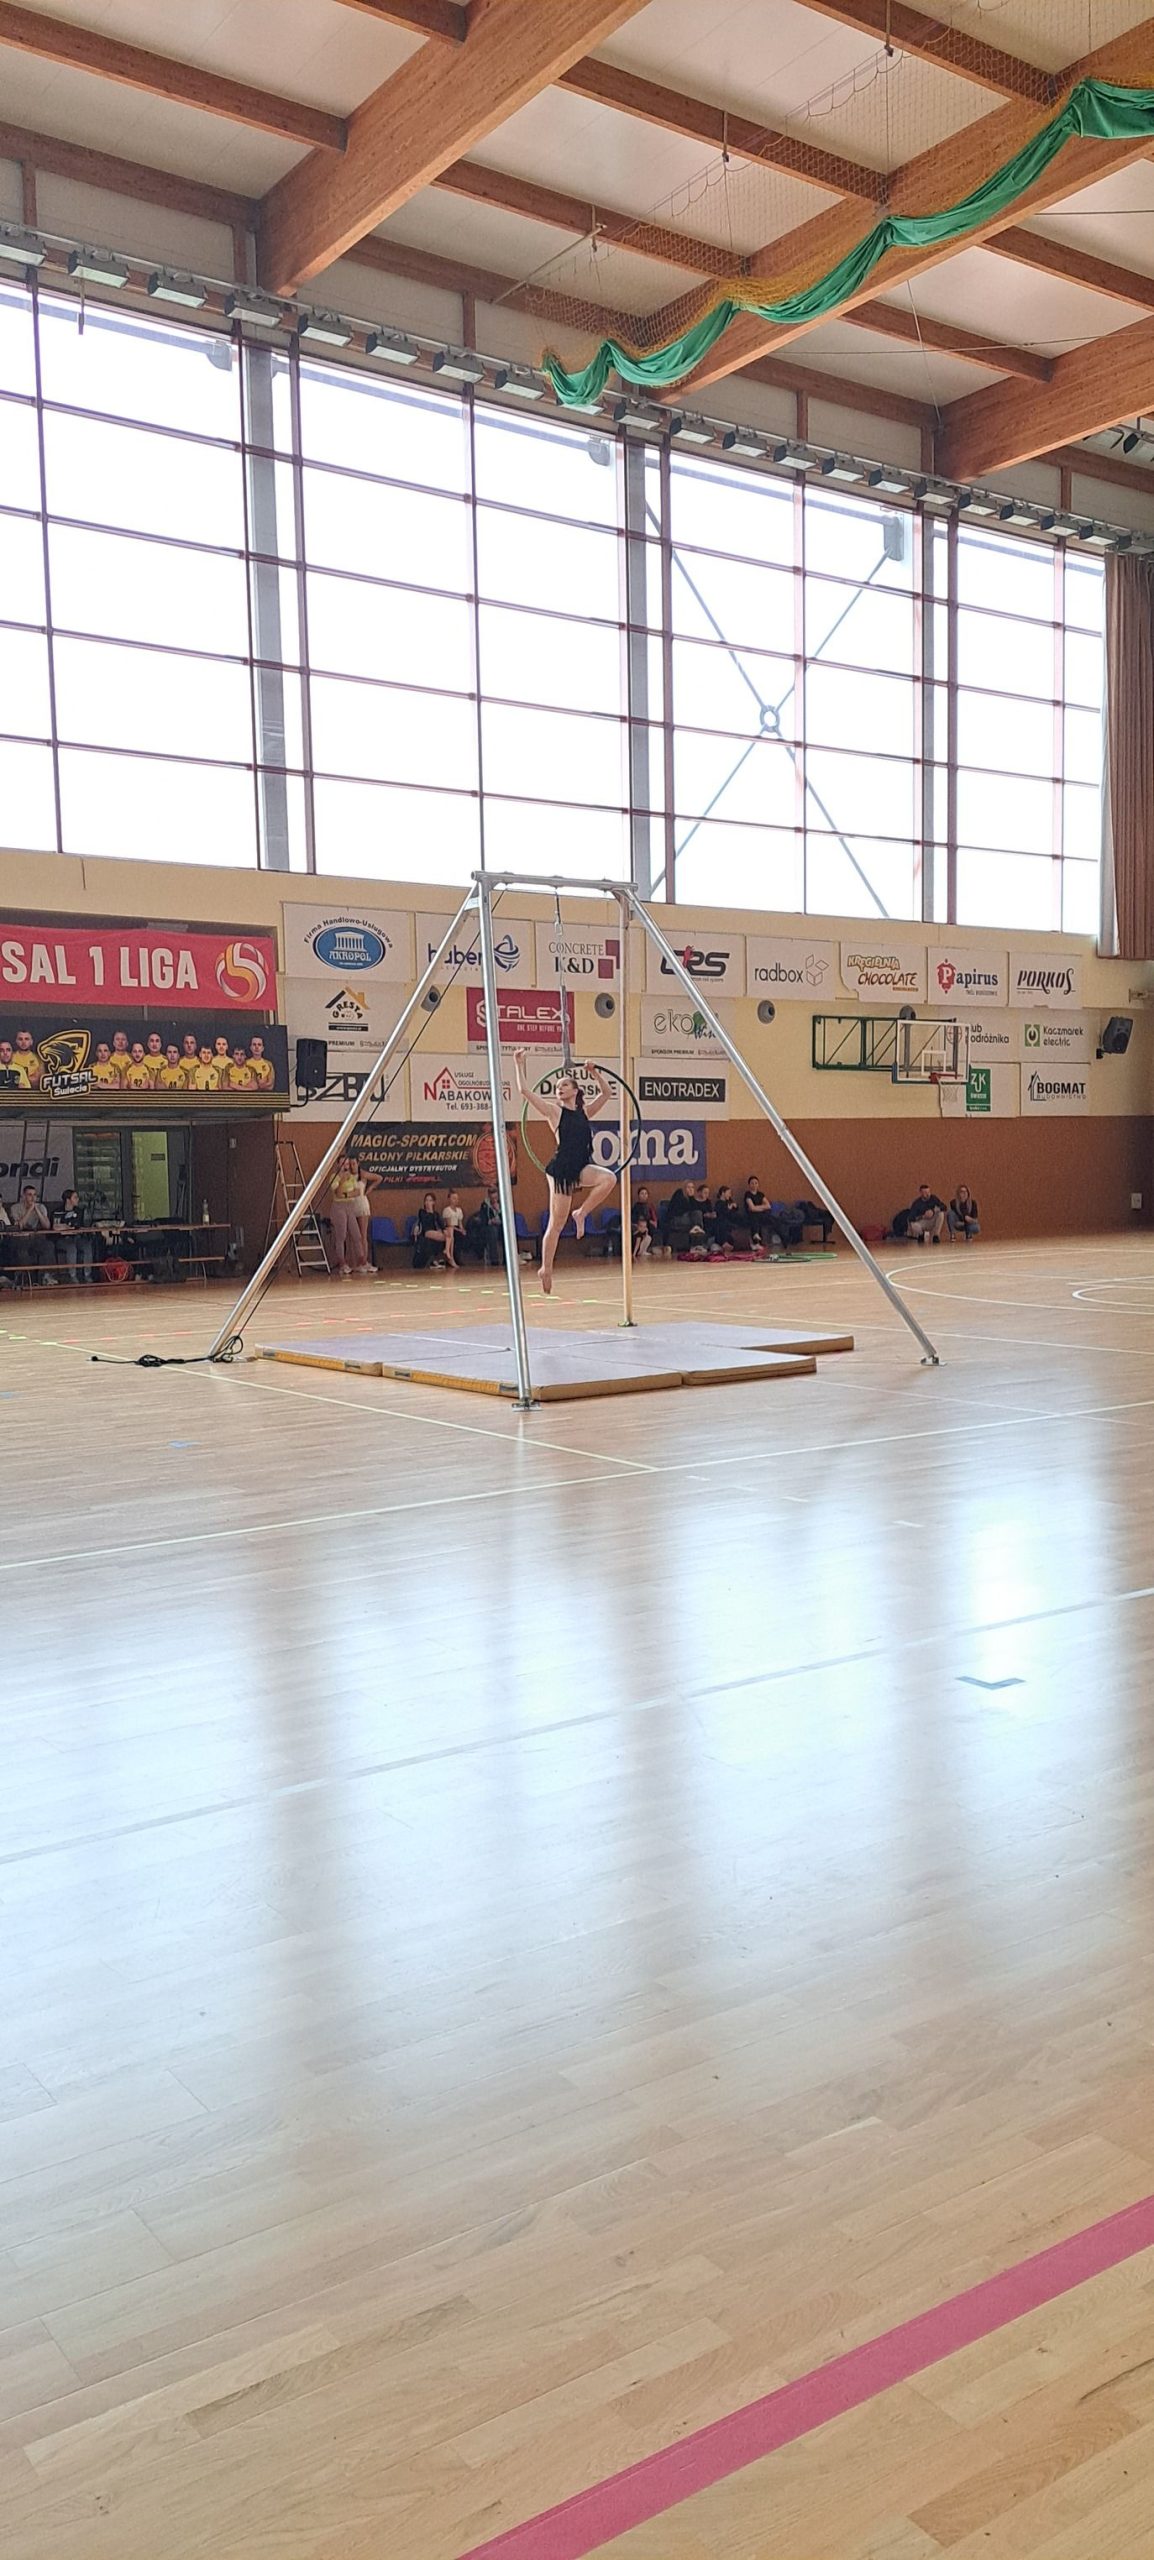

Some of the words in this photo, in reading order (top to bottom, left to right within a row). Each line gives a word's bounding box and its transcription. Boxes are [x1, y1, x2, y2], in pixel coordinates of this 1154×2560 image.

[304, 924, 323, 944] Firma
[329, 951, 372, 961] AKROPOL
[548, 942, 605, 955] CONCRETE
[1, 941, 76, 985] SAL
[89, 946, 105, 986] 1
[119, 947, 198, 989] LIGA
[755, 963, 804, 983] radbox
[858, 972, 917, 986] CHOCOLATE
[943, 966, 998, 988] Papirus
[1017, 968, 1075, 995] PORKOS
[332, 1001, 363, 1019] GRESTA
[654, 1009, 694, 1034] eko
[1043, 1026, 1083, 1036] Kaczmarek
[1043, 1037, 1071, 1046] electric
[43, 1071, 97, 1089] FUTSAL
[645, 1082, 720, 1097] ENOTRADEX
[1037, 1082, 1086, 1094] BOGMAT
[351, 1134, 478, 1148] MAGIC-SPORT.COM
[359, 1152, 403, 1162] SALONY
[406, 1151, 469, 1161] PIŁKARSKIE
